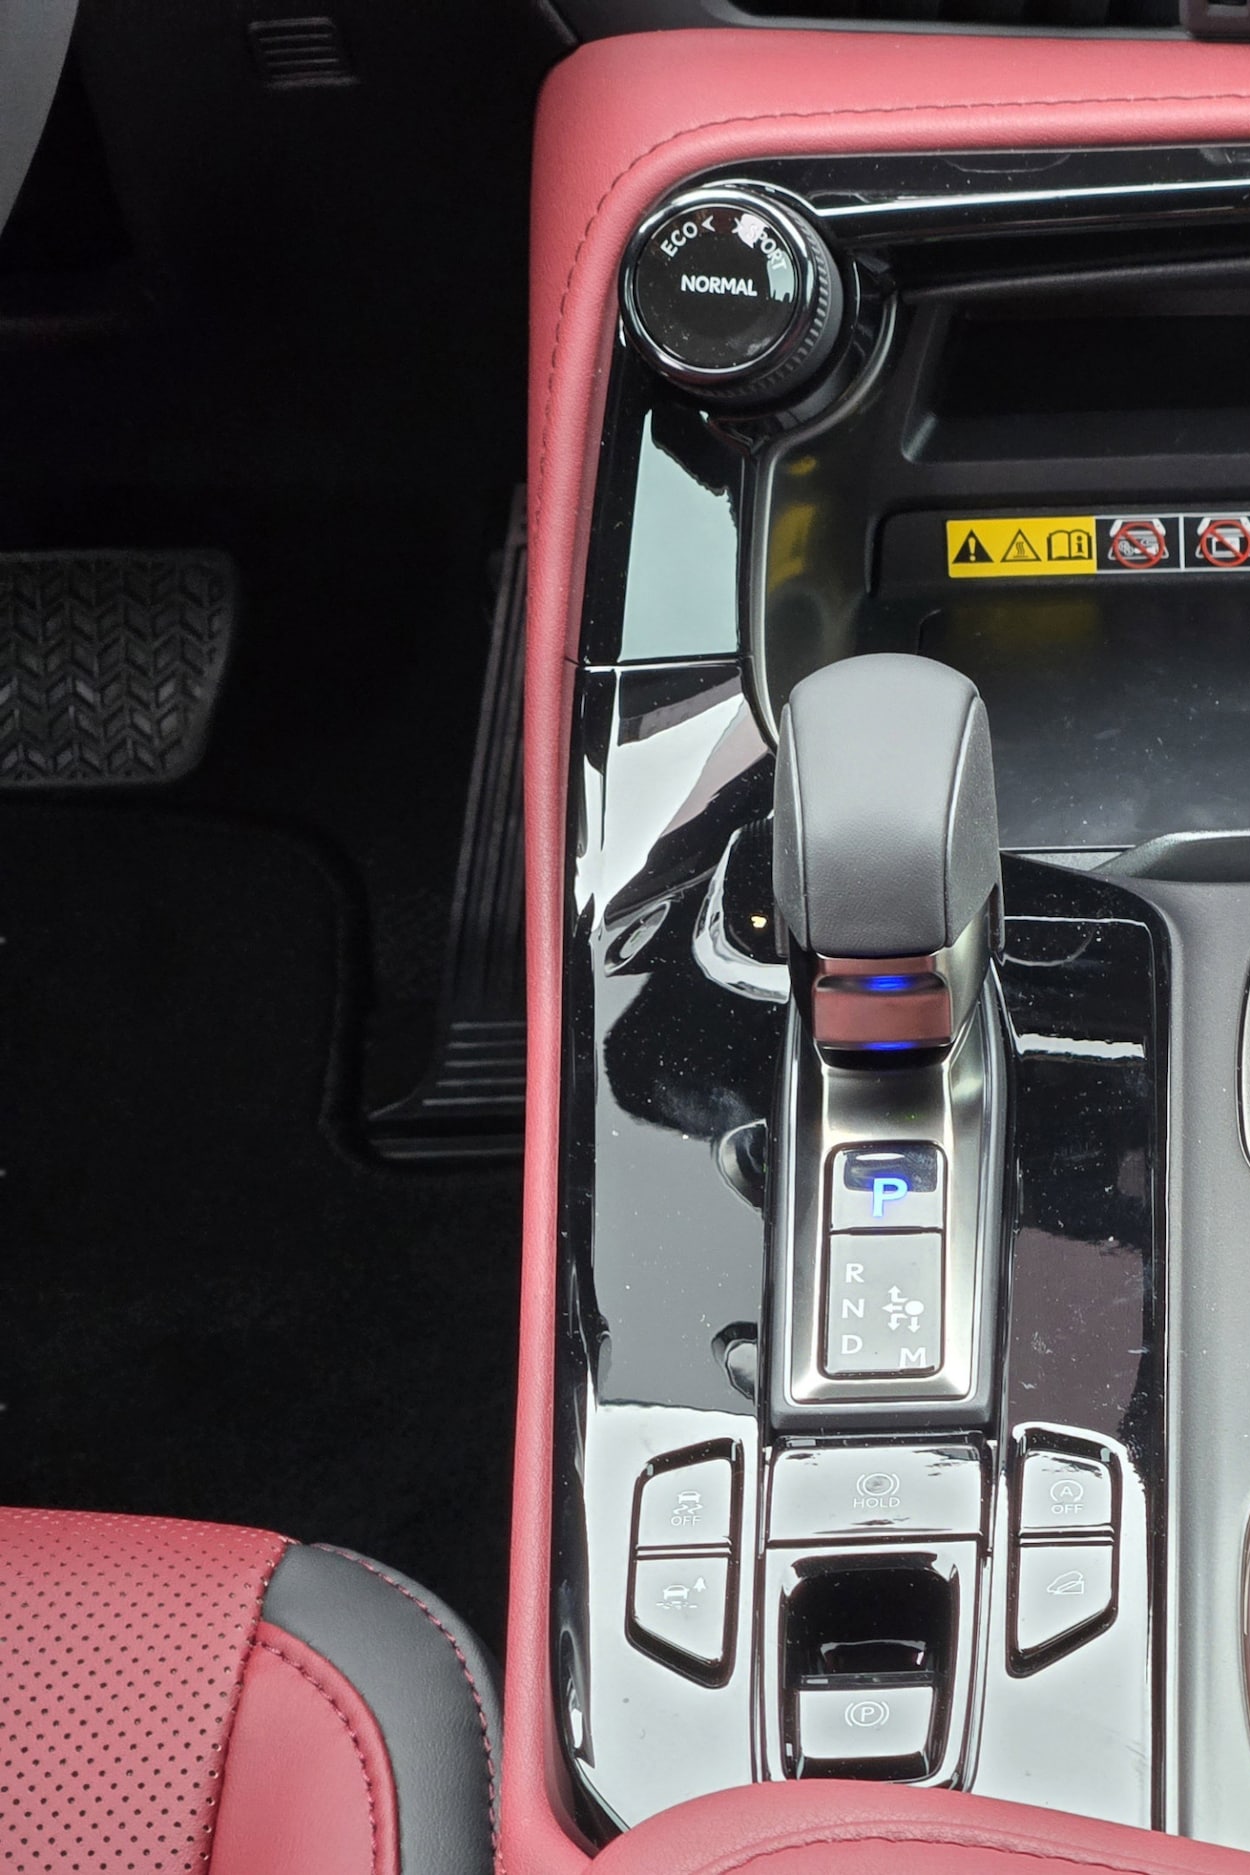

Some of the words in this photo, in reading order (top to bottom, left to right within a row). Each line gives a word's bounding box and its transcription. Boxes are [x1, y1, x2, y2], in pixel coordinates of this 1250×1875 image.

[660, 221, 698, 257] ECO
[680, 274, 758, 297] NORMAL
[871, 1177, 908, 1217] P
[845, 1263, 864, 1283] R
[841, 1298, 864, 1319] N
[841, 1334, 863, 1355] D
[900, 1347, 927, 1368] M
[853, 1497, 901, 1509] HOLD
[1051, 1503, 1084, 1514] OFF
[670, 1515, 702, 1526] OFF
